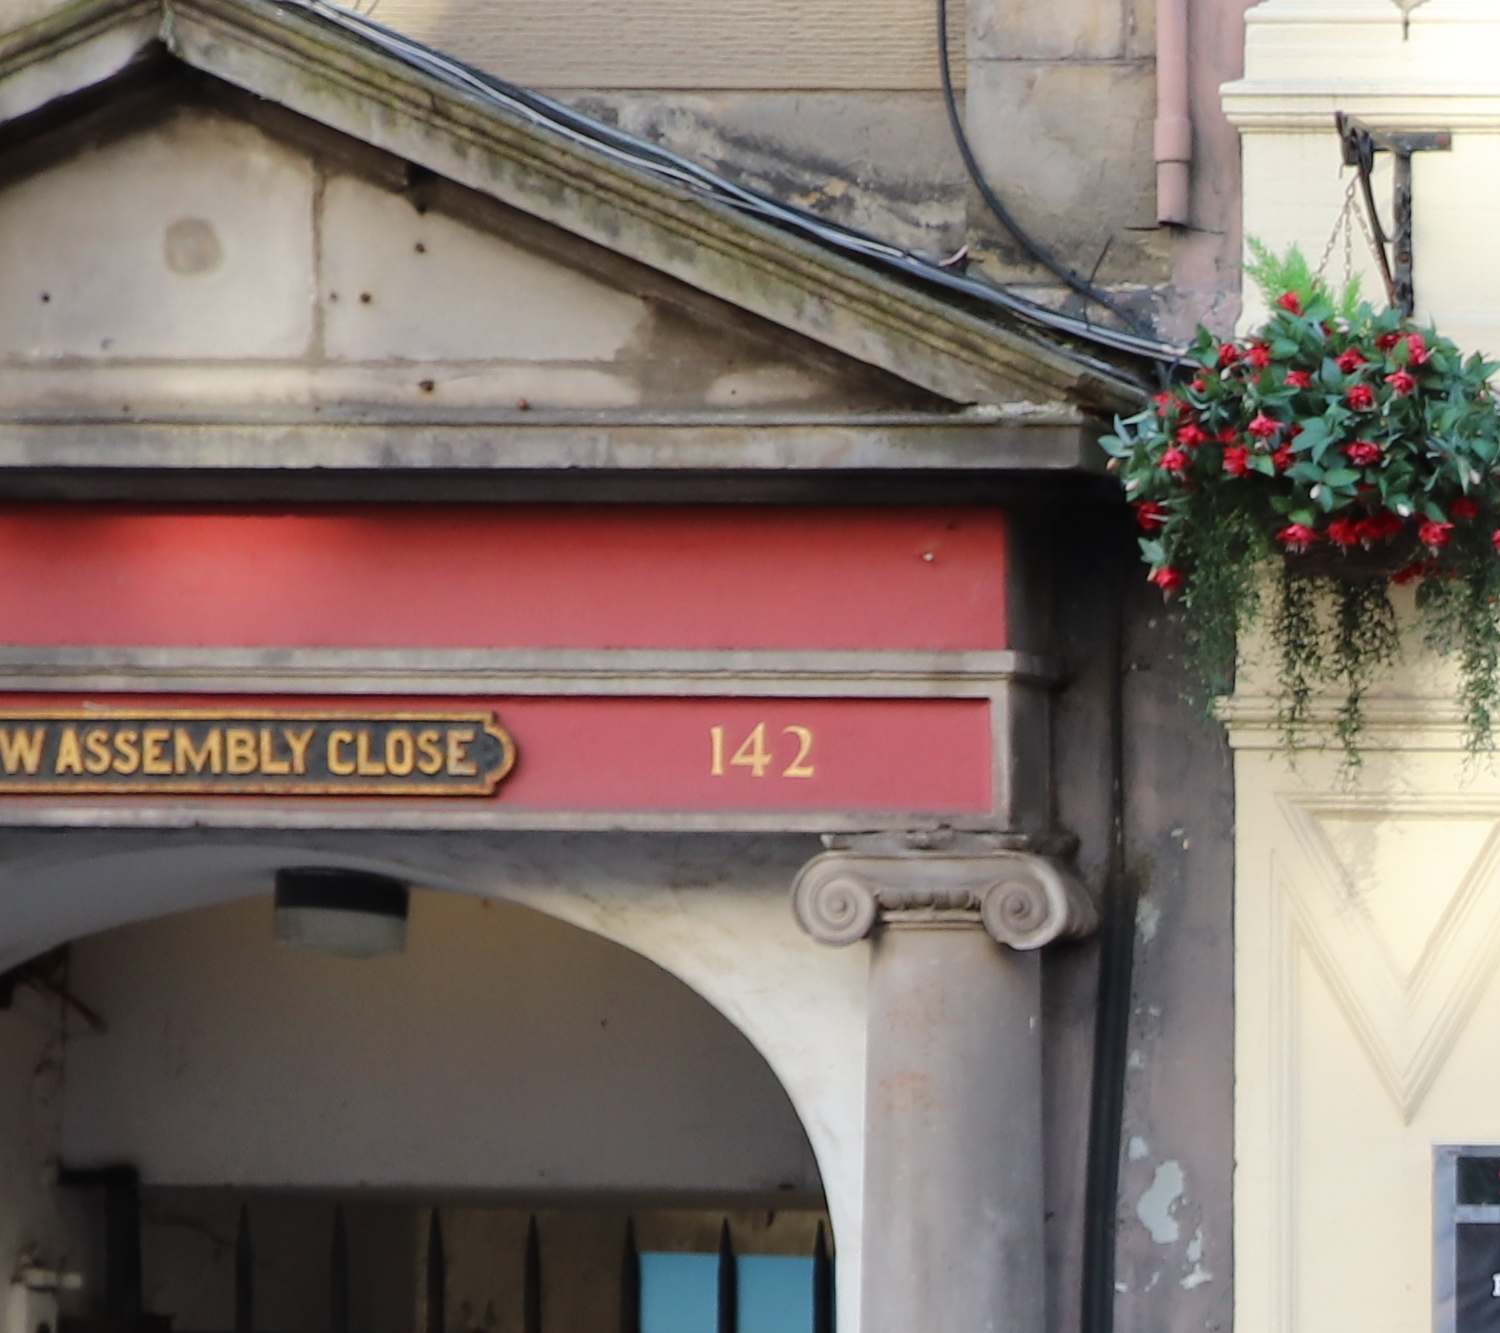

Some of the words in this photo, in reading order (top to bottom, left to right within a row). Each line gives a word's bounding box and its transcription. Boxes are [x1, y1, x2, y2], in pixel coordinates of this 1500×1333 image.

[55, 726, 309, 776] ASSEMBLY
[326, 726, 478, 777] CLOSE
[708, 721, 816, 779] 142
